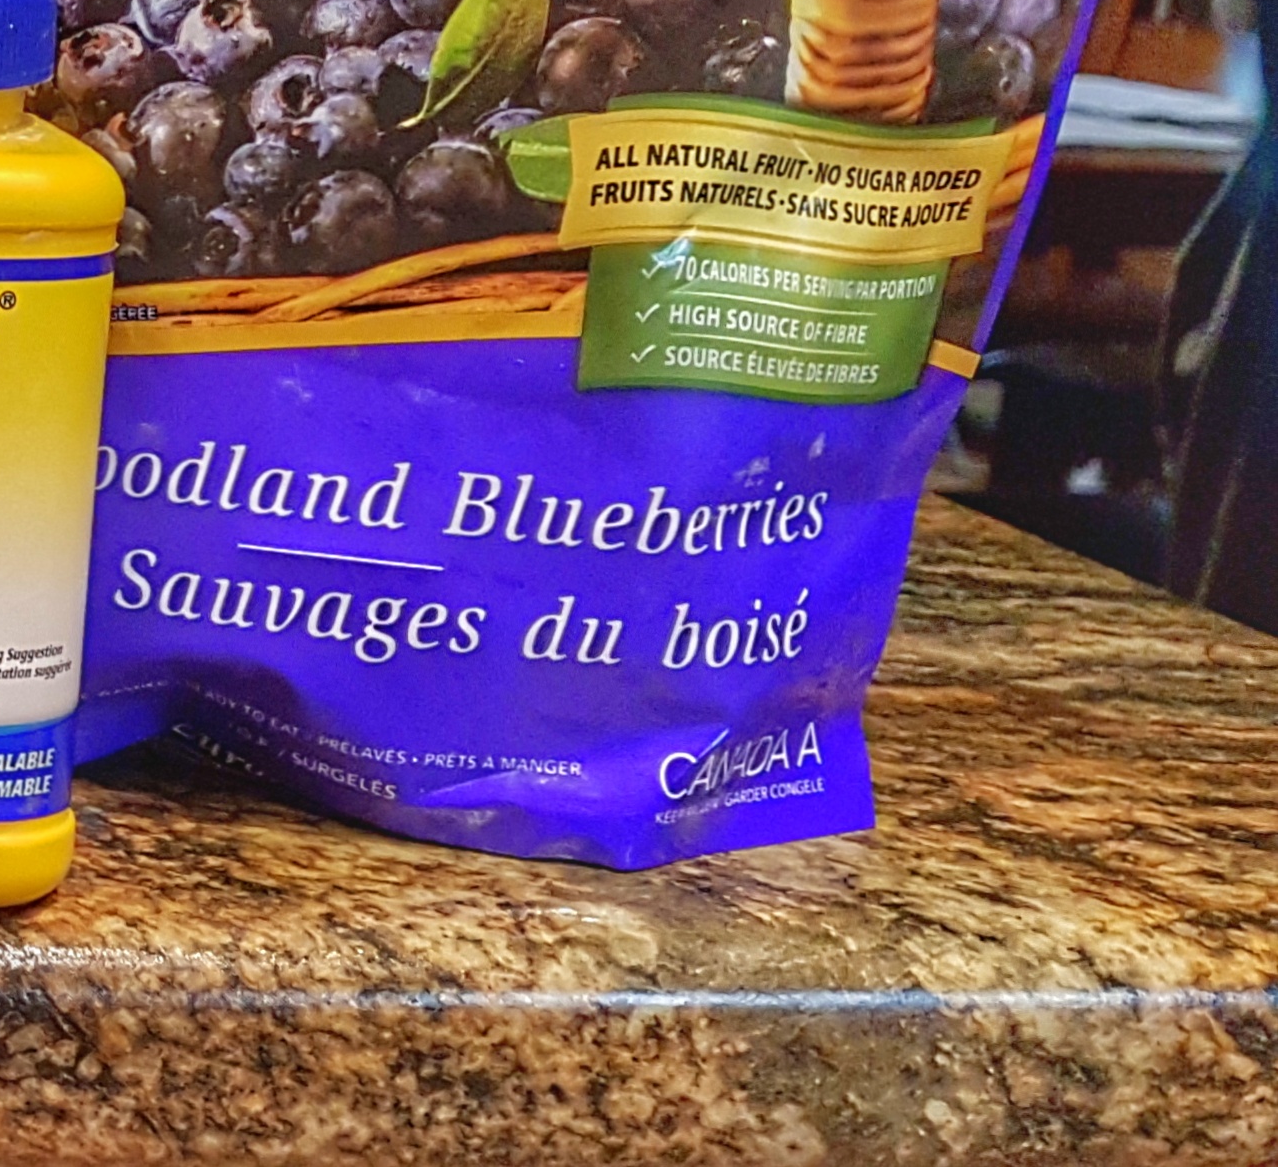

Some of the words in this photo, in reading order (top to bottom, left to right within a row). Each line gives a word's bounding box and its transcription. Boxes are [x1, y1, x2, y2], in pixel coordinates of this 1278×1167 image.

[594, 144, 639, 171] ALL
[646, 143, 750, 174] NATURAL
[845, 165, 908, 194] SUGAR
[909, 168, 982, 194] ADDED
[590, 178, 674, 207] FRUITS
[679, 180, 776, 211] NATURELS
[842, 204, 899, 229] SUCRE
[899, 195, 975, 229] AJOUTÉ
[673, 254, 698, 282] 70
[699, 258, 771, 288] CALORIES
[774, 269, 801, 293] PER
[855, 281, 879, 300] PAR
[879, 273, 937, 300] PORTION
[668, 303, 722, 330] HIGH
[725, 308, 799, 340] SOURCE
[803, 320, 823, 341] OF
[824, 323, 869, 345] FIBRE
[664, 344, 743, 373] SOURCE
[746, 349, 805, 380] ÉLEVÉE
[805, 361, 825, 382] DE
[826, 363, 881, 385] FIBRES
[443, 469, 829, 556] Blueberries
[112, 547, 488, 665] Sauvages
[523, 594, 624, 668] du
[661, 586, 810, 671] boisé
[6, 644, 64, 665] Suggestion
[499, 756, 582, 776] MANGER
[796, 720, 823, 768] A
[724, 786, 769, 807] GARDER
